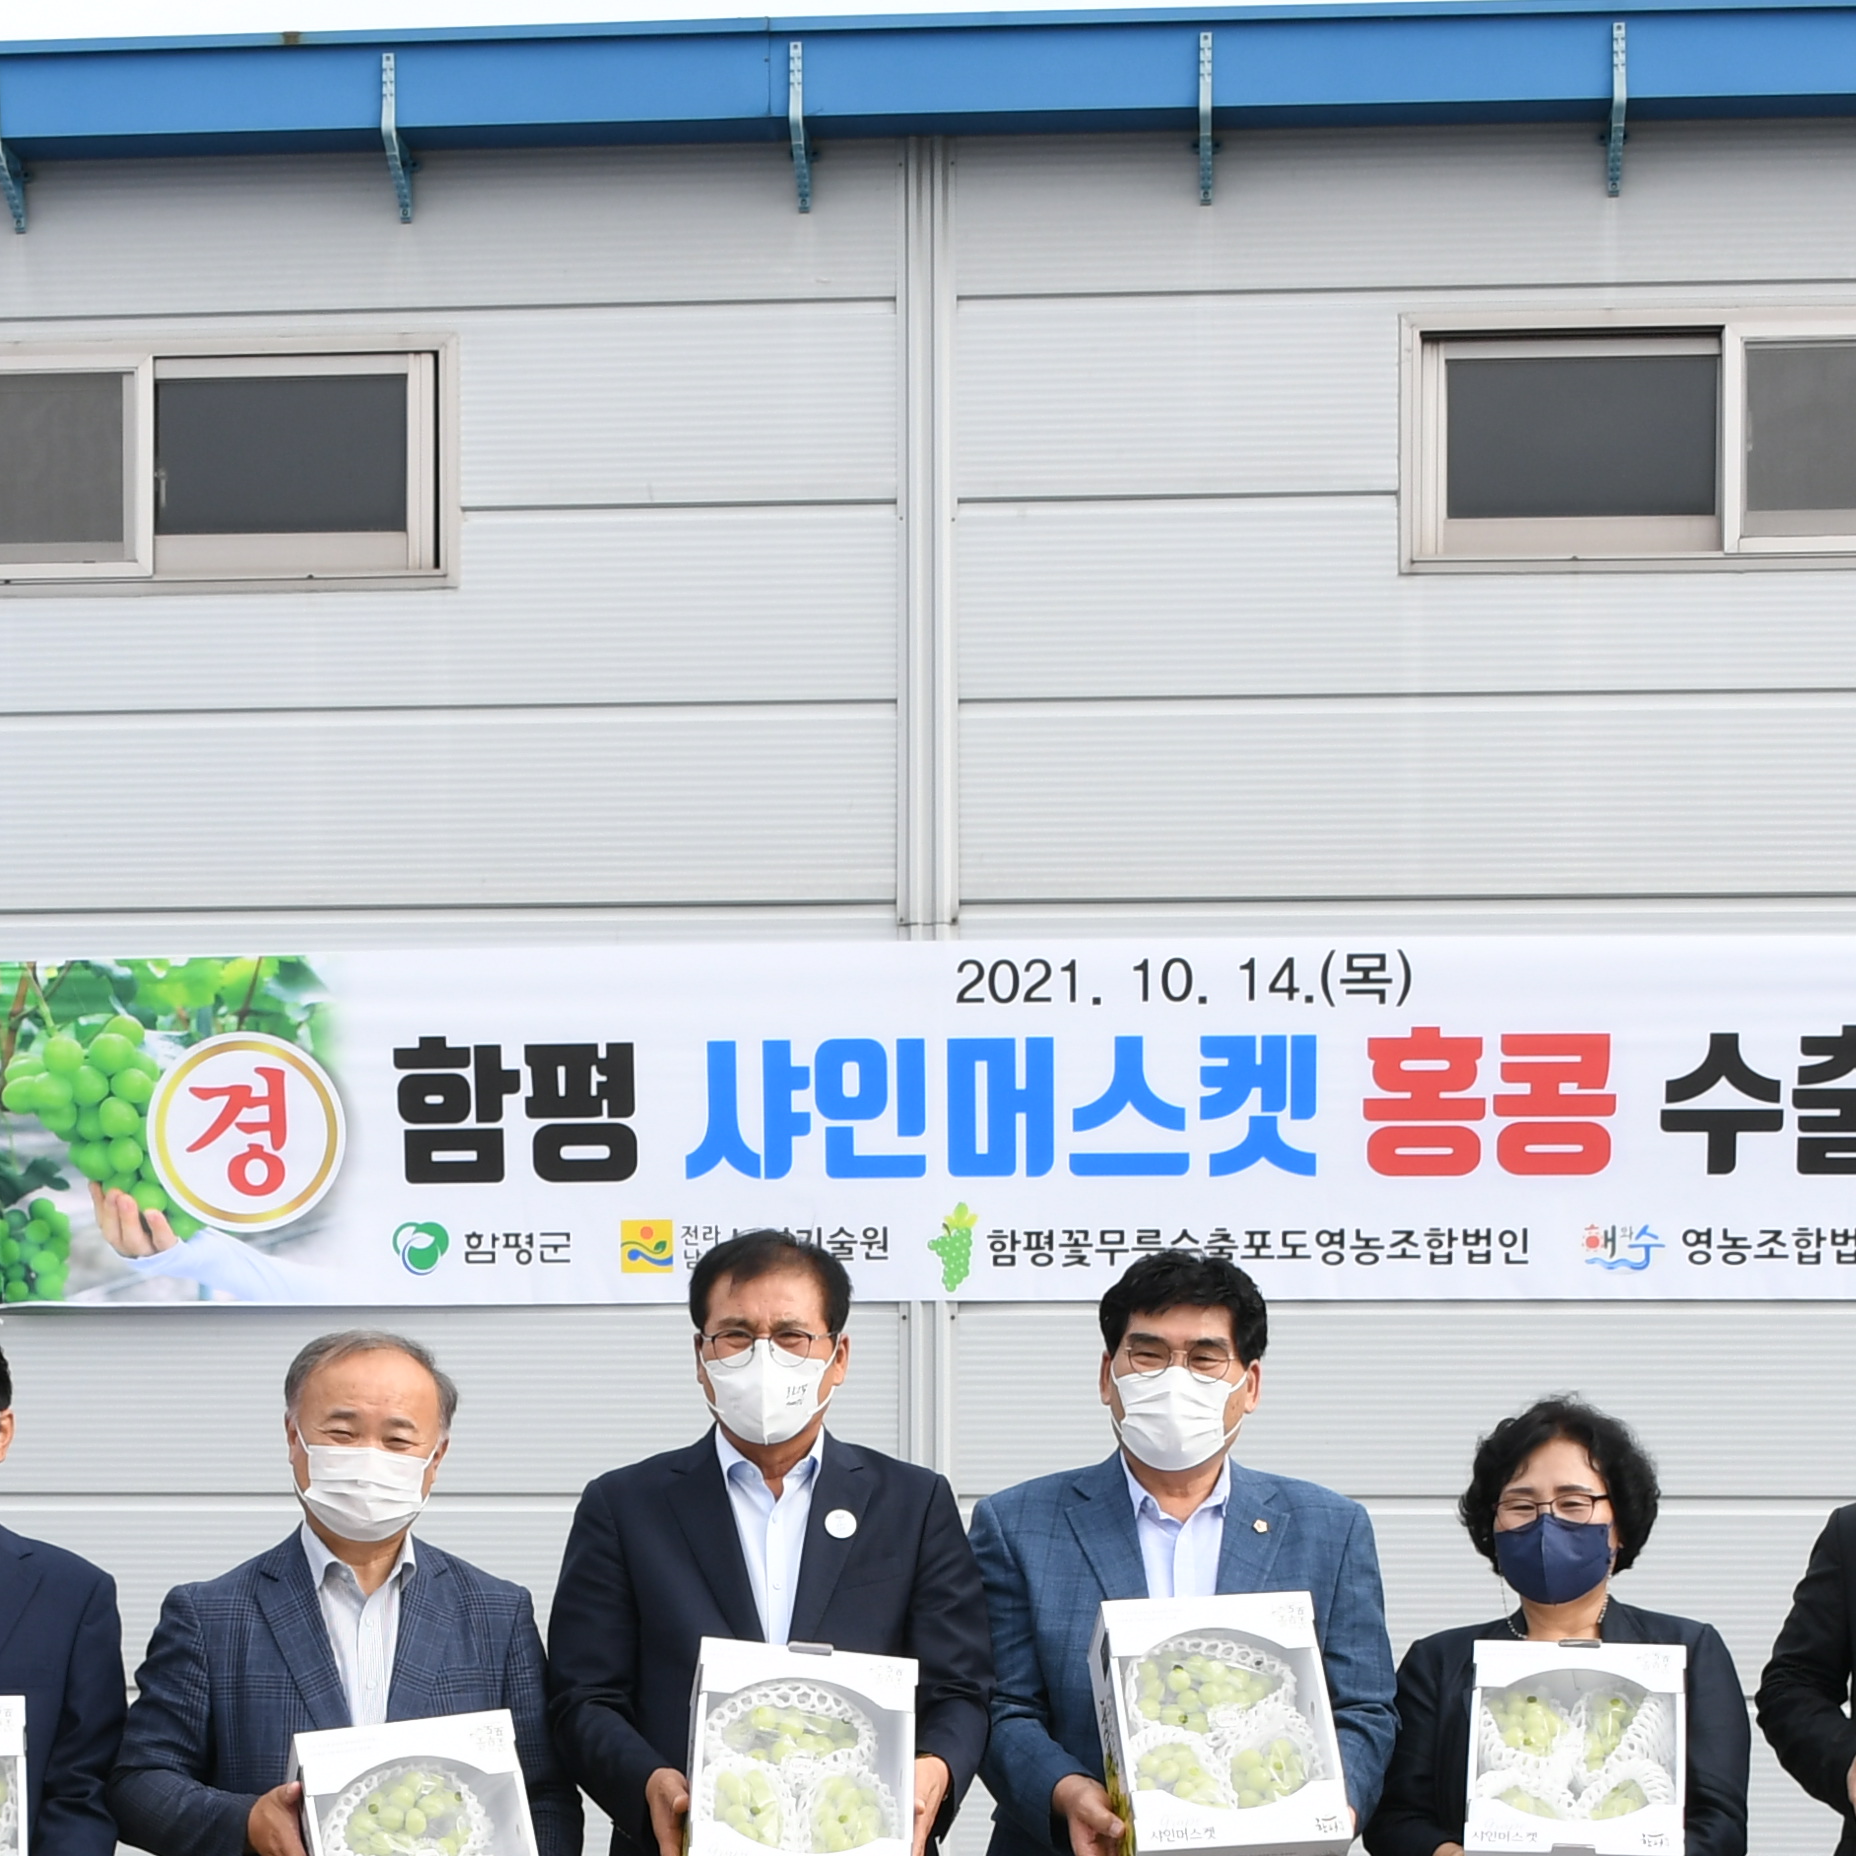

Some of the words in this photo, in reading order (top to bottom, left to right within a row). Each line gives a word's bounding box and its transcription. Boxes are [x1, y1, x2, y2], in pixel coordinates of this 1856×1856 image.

[955, 958, 1102, 1006] 2021.
[1133, 957, 1208, 1005] 10.
[1238, 949, 1413, 1008] 14.(목)
[185, 1066, 289, 1198] 경
[392, 1034, 639, 1184] 함평
[684, 1033, 1318, 1180] 샤인머스켓
[1362, 1026, 1617, 1177] 홍콩
[463, 1229, 572, 1267] 함평군
[680, 1224, 721, 1247] 전라
